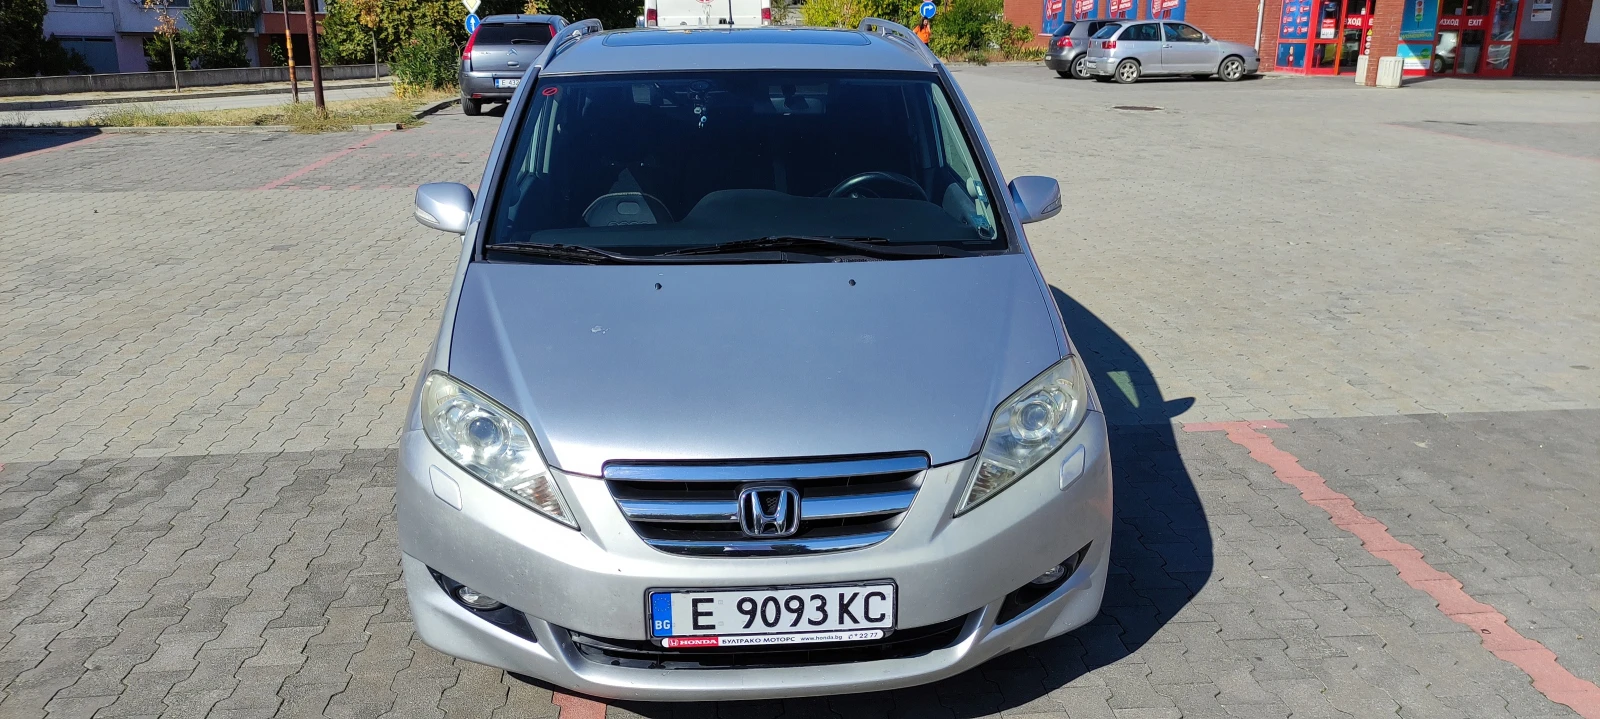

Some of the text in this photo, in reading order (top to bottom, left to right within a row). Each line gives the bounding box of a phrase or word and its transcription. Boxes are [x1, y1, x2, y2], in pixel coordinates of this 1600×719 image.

[691, 591, 887, 630] E 9093 KC
[654, 619, 671, 631] BG
[679, 638, 717, 646] HONDA
